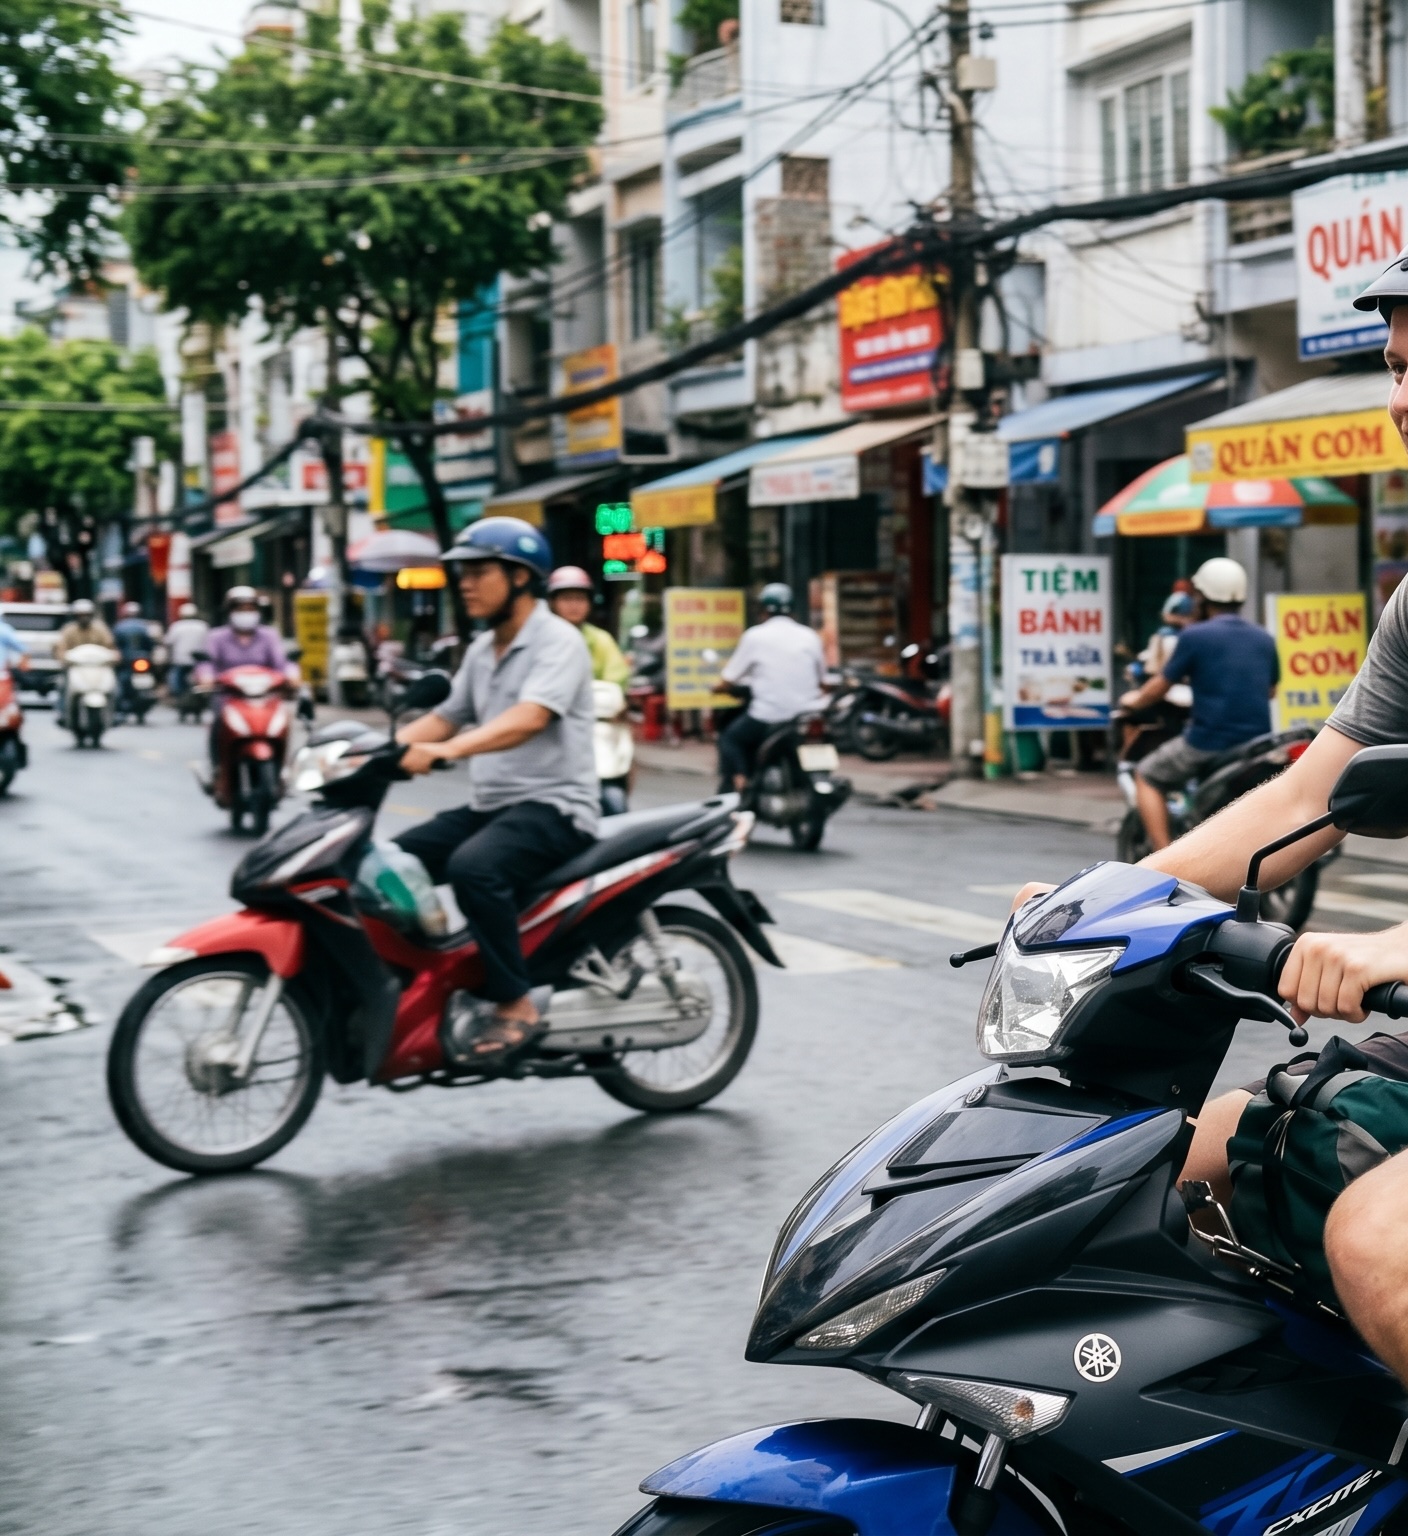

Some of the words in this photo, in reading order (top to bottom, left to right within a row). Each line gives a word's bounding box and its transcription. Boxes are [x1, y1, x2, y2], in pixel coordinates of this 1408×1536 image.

[1307, 200, 1404, 281] QUÁN
[1218, 427, 1302, 476] QUÁN
[1311, 423, 1384, 460] CƠM
[1021, 563, 1099, 597] TIỆM
[1019, 601, 1103, 635] BÁNH
